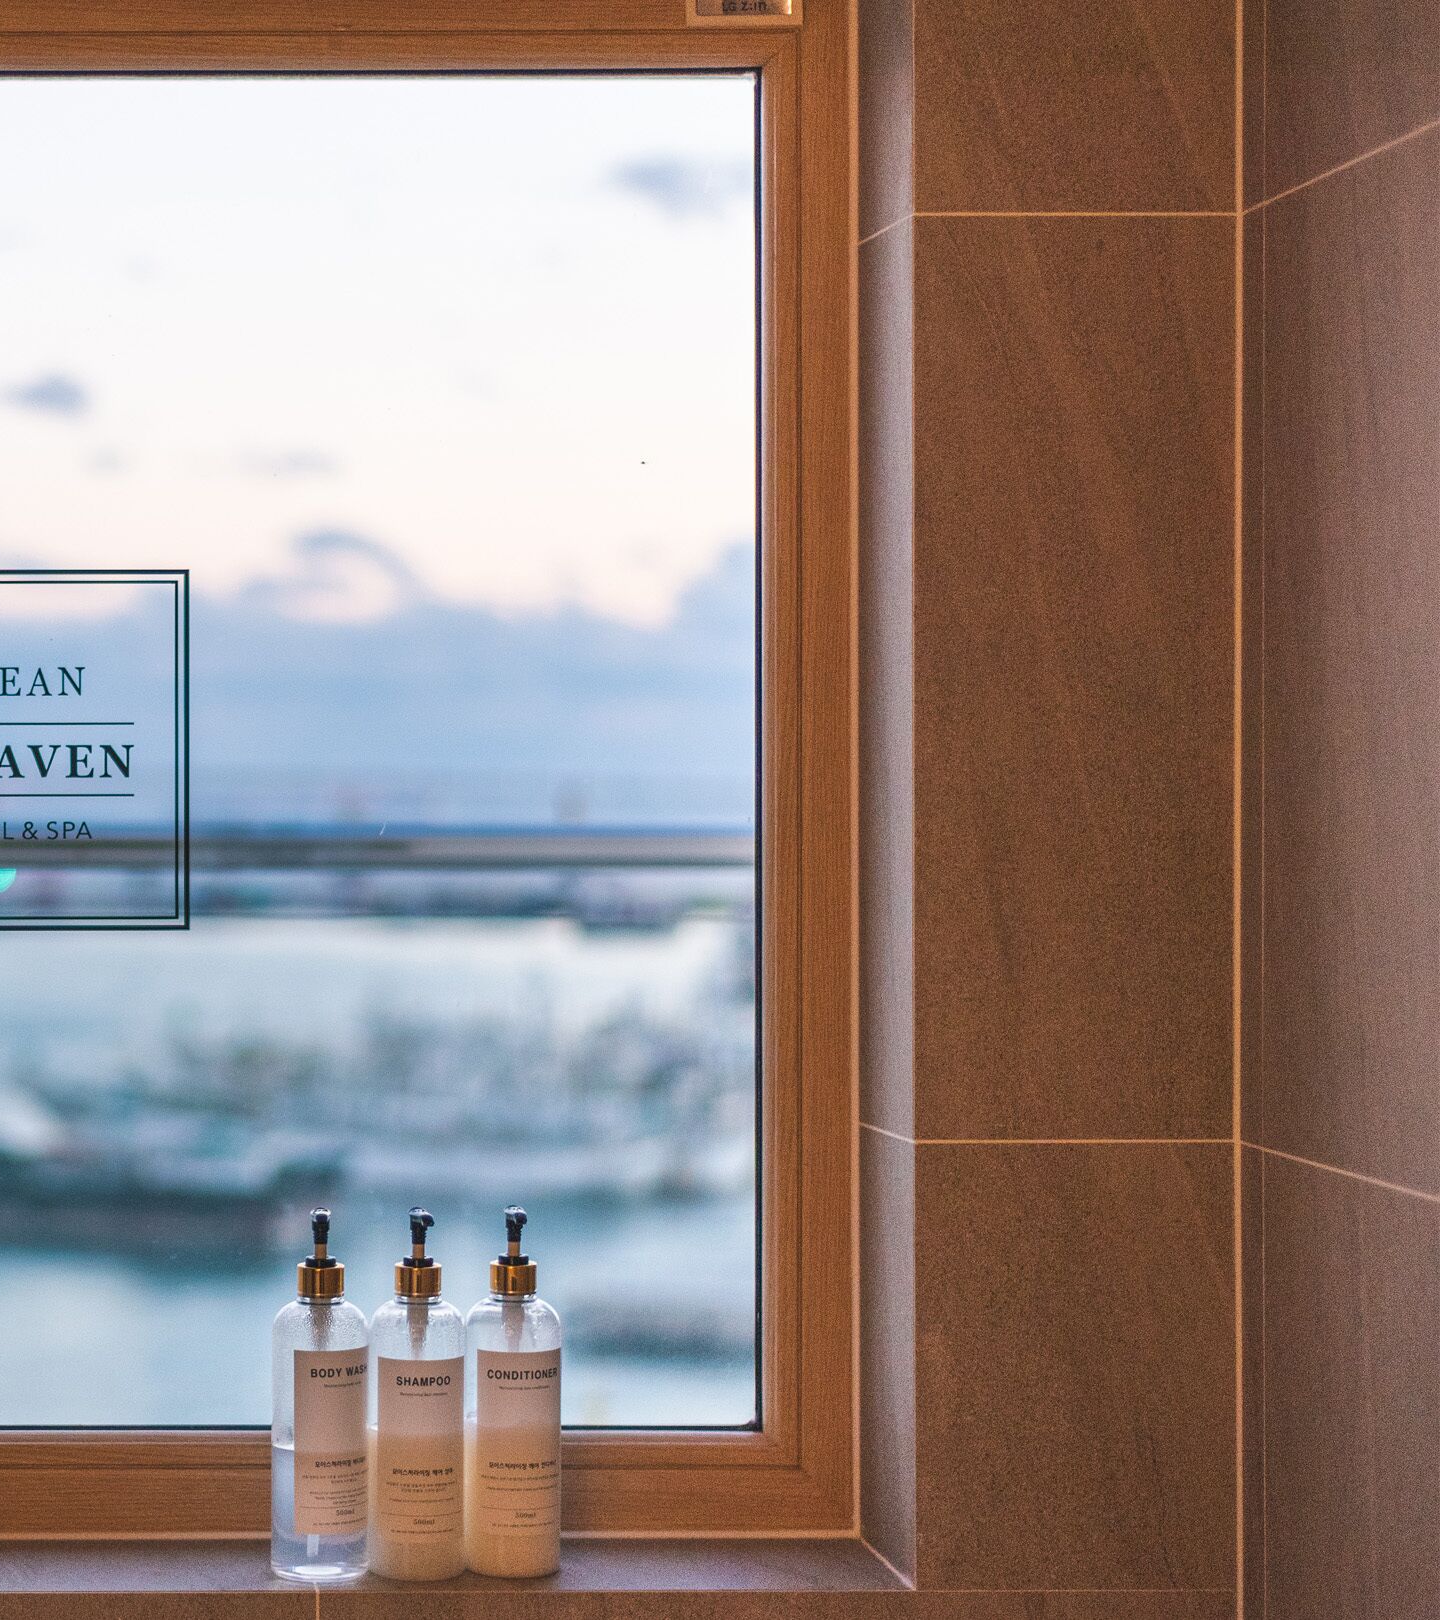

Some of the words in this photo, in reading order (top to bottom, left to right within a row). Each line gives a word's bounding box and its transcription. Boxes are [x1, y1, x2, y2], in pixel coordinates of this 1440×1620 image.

[22, 821, 39, 841] &
[46, 821, 93, 841] SPA
[310, 1368, 342, 1378] BODY
[487, 1367, 558, 1380] CONDITIONER
[396, 1375, 451, 1386] SHAMPOO
